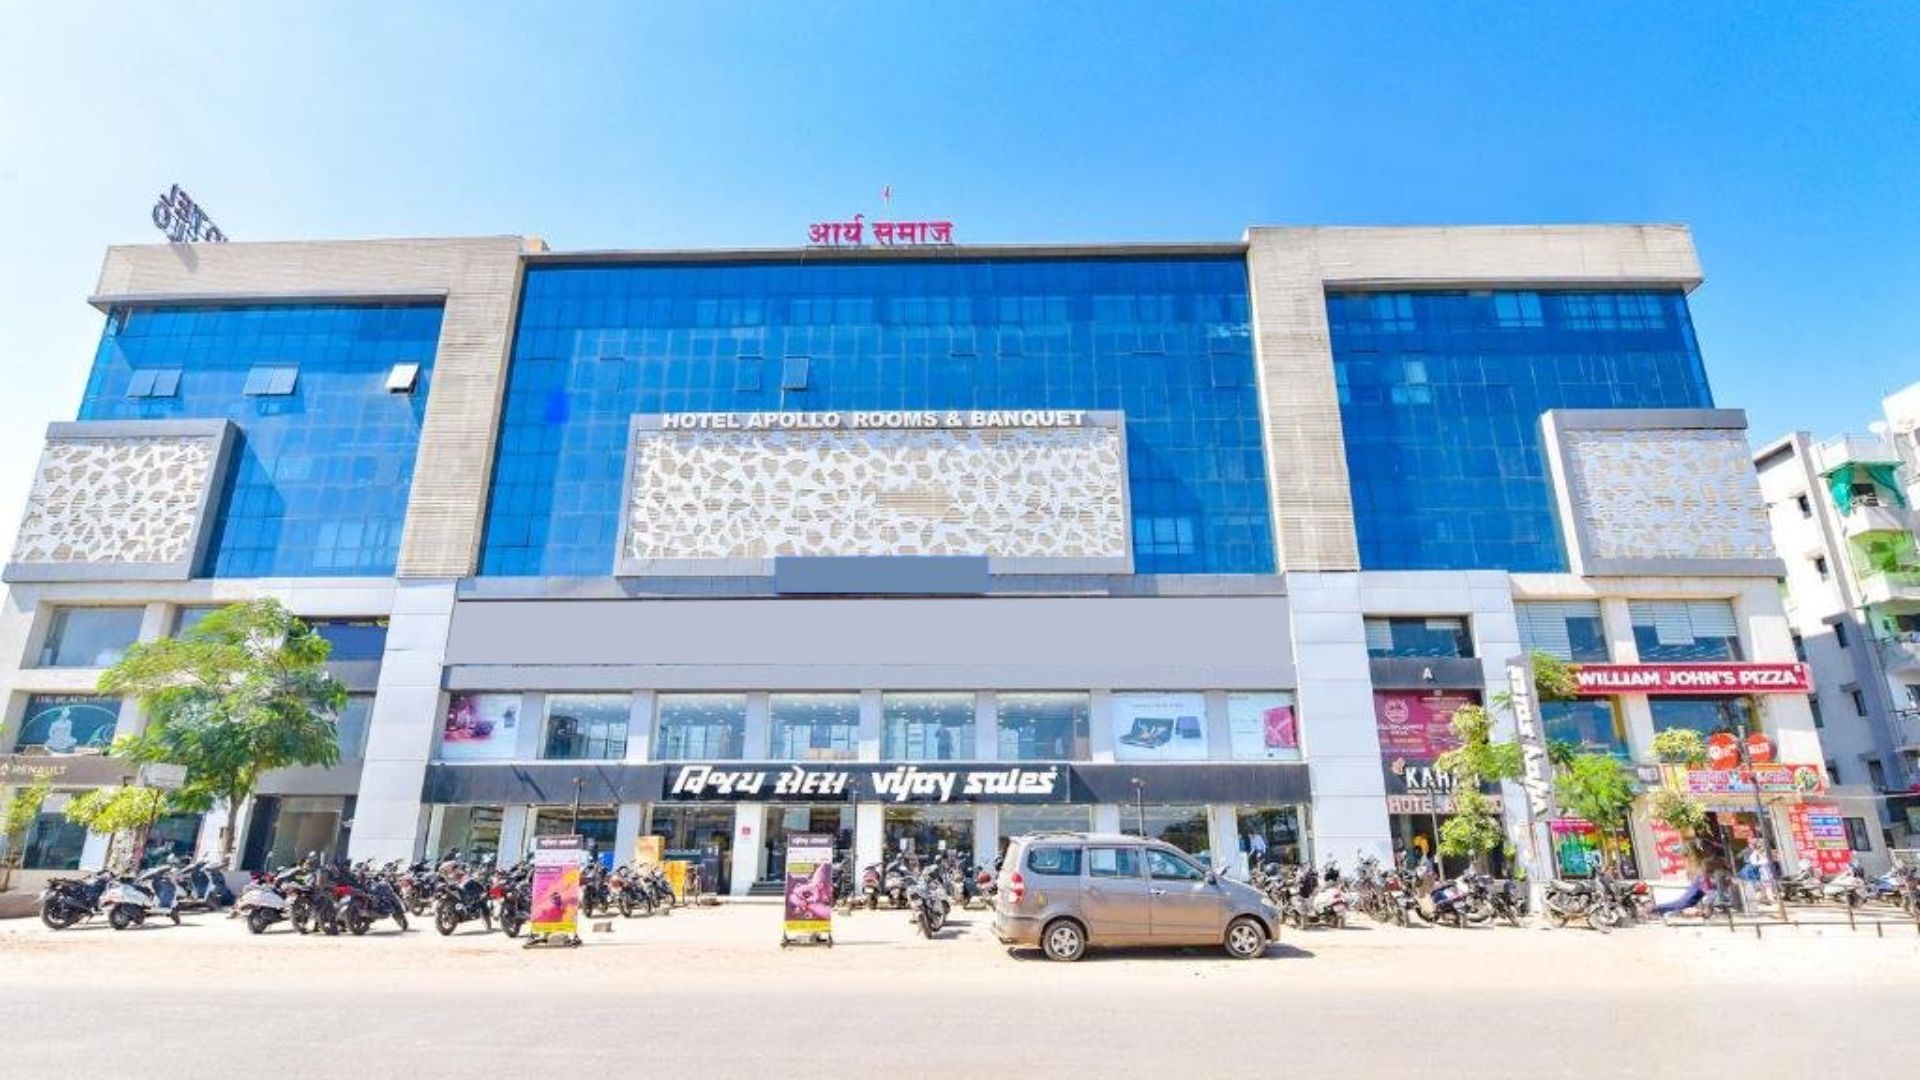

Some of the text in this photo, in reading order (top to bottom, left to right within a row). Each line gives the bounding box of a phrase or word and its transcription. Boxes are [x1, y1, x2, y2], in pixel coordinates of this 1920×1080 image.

[809, 213, 954, 246] आर्य समाज
[662, 410, 1086, 430] HOTEL APOLLO ROOMS & BANQUET
[1577, 670, 1799, 686] WILLIAM JOHN'S PIZZA
[871, 765, 1058, 802] vijay sales
